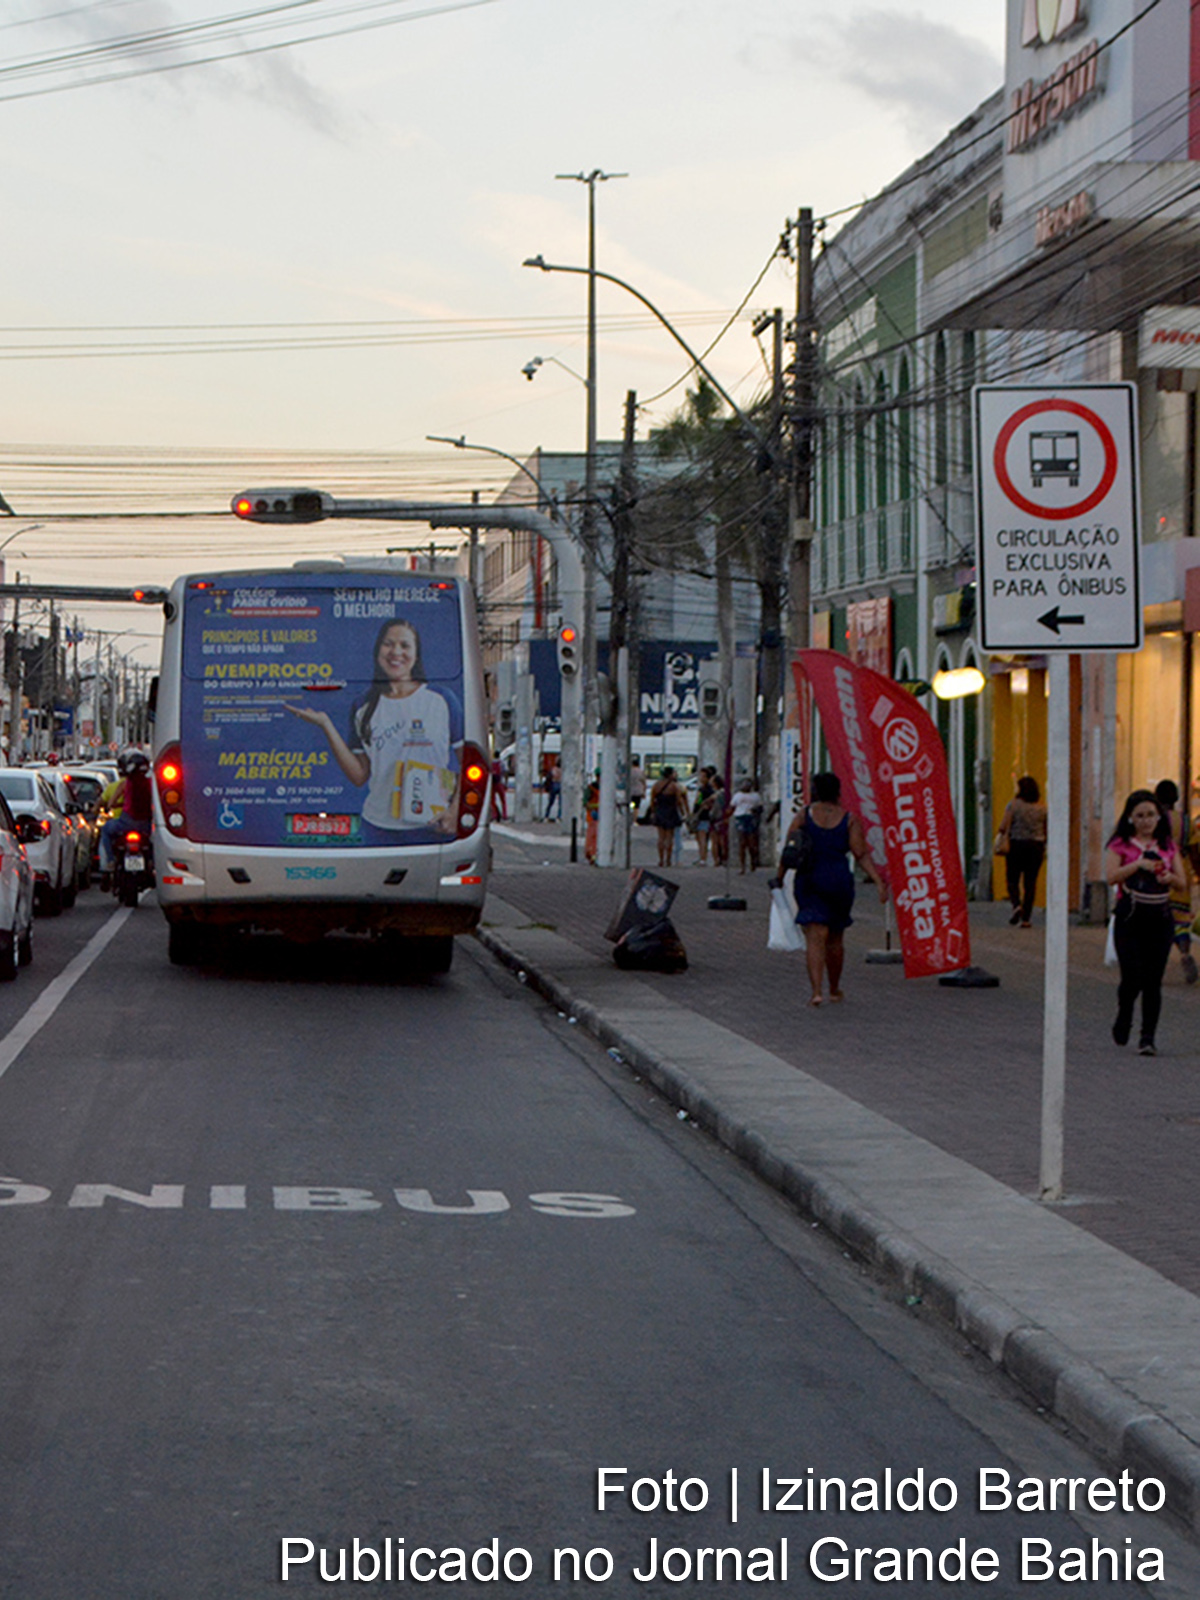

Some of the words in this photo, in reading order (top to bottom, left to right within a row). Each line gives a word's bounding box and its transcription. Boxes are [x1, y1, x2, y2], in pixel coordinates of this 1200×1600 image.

[996, 523, 1120, 549] CIRCULAÇÃO
[1006, 553, 1111, 572] EXCLUSIVA
[993, 578, 1048, 597] PARA
[1058, 572, 1127, 597] ÔNIBUS
[232, 597, 268, 607] PADRE
[270, 595, 308, 607] OVÍDIO
[333, 603, 342, 618] O
[202, 628, 260, 643] PRINCÍPIOS
[262, 630, 268, 643] E
[270, 630, 318, 643] VALORES
[204, 663, 333, 678] #VEMPROCPO
[204, 680, 218, 689] DO
[221, 680, 253, 689] GRUPO
[261, 680, 277, 688] AO
[218, 748, 329, 765] MATRÍCULAS
[234, 766, 312, 779] ABERTAS
[892, 773, 936, 940] Lucidata
[922, 787, 946, 890] COMPUTADOR
[939, 905, 951, 927] NA
